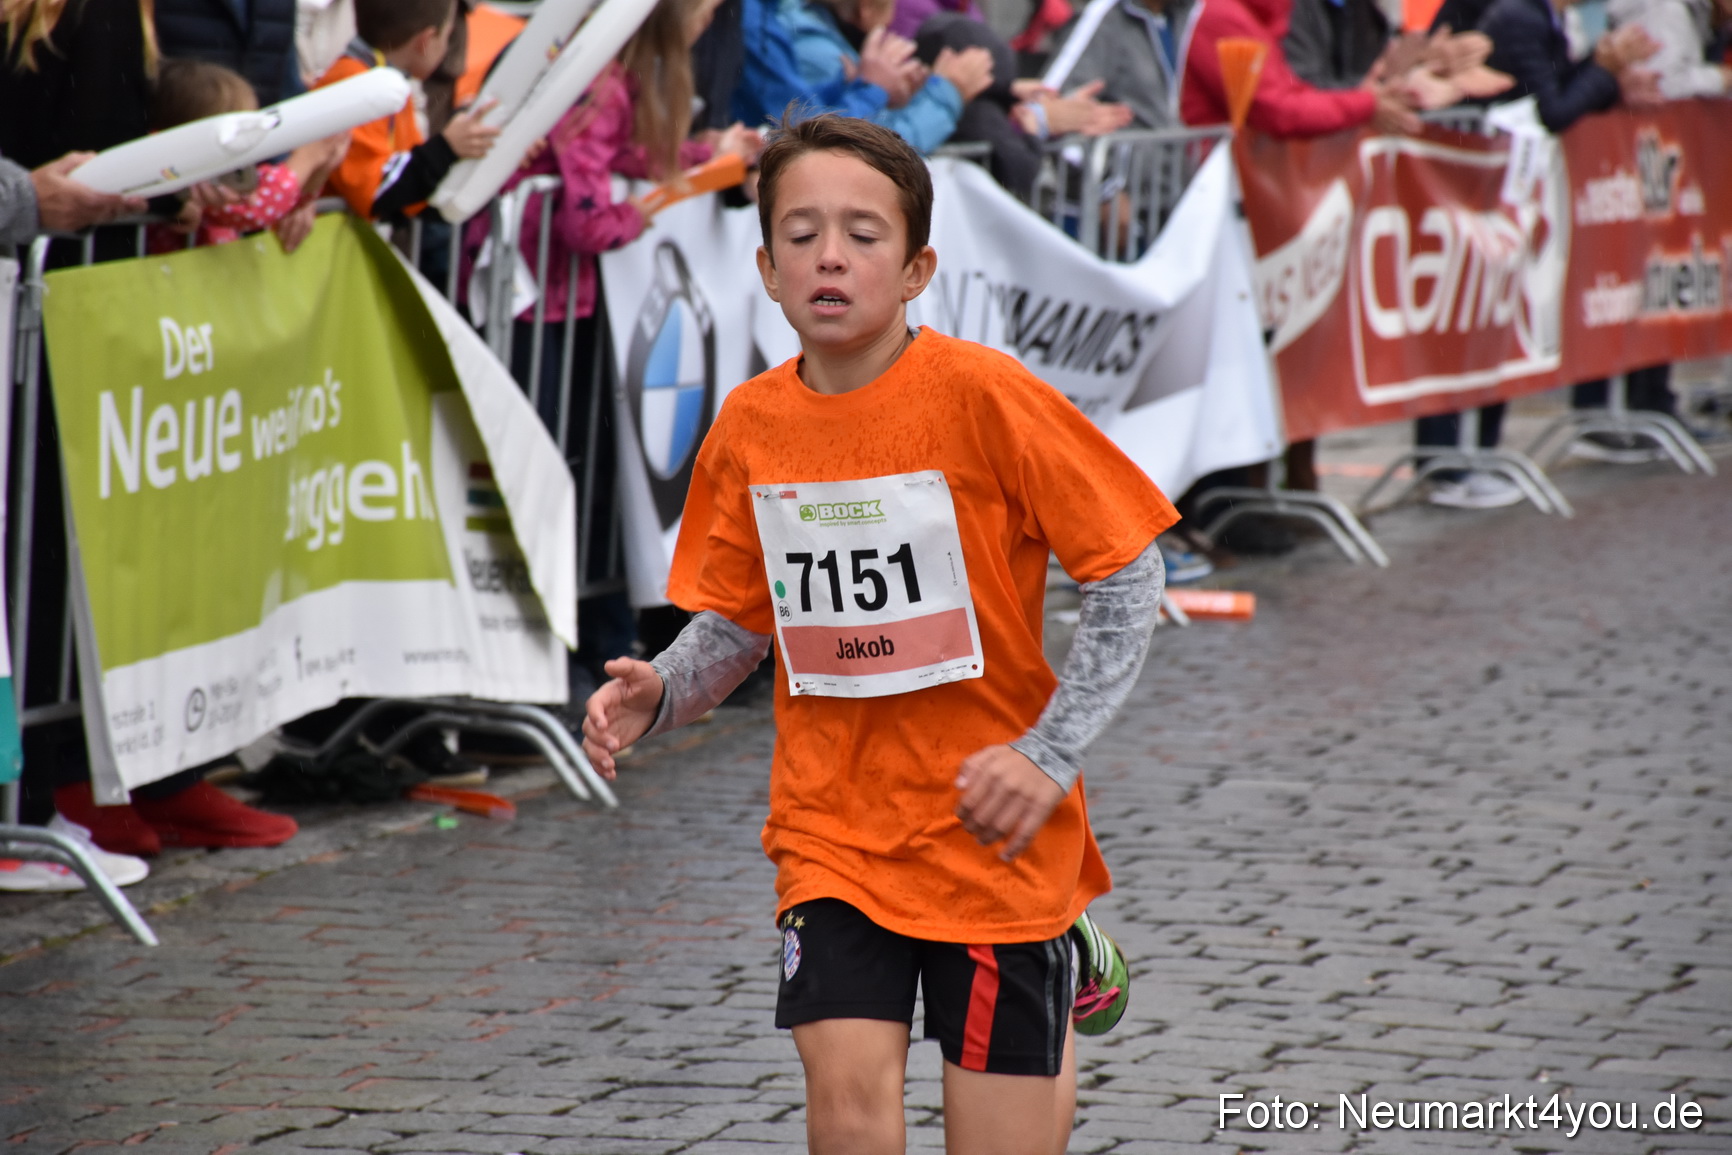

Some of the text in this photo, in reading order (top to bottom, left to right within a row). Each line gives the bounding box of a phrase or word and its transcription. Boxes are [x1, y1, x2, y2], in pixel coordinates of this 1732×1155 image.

[159, 316, 214, 380] Der
[99, 385, 242, 500] Neue
[817, 499, 885, 521] BOCK
[786, 543, 922, 613] 7151
[779, 605, 791, 618] B6
[836, 635, 895, 660] Jakob
